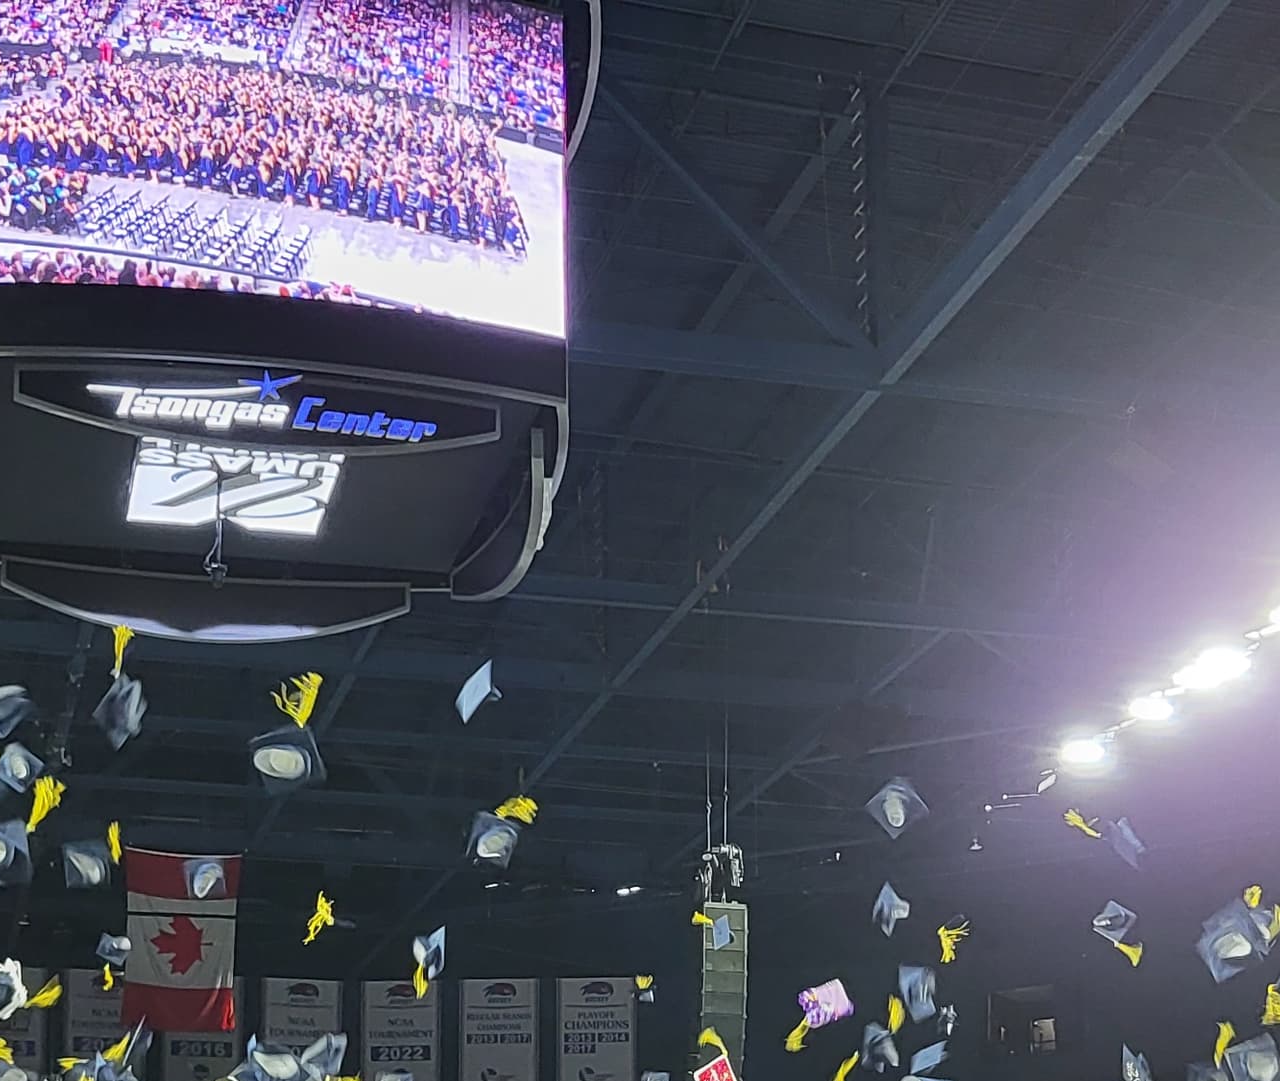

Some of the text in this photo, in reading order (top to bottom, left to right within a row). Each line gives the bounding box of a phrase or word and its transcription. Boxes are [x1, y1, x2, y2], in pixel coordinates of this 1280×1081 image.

[86, 383, 438, 443] Tsongas Center
[564, 1020, 630, 1030] CHAMPIONS
[179, 1043, 226, 1057] 2016
[379, 1047, 424, 1060] 2022
